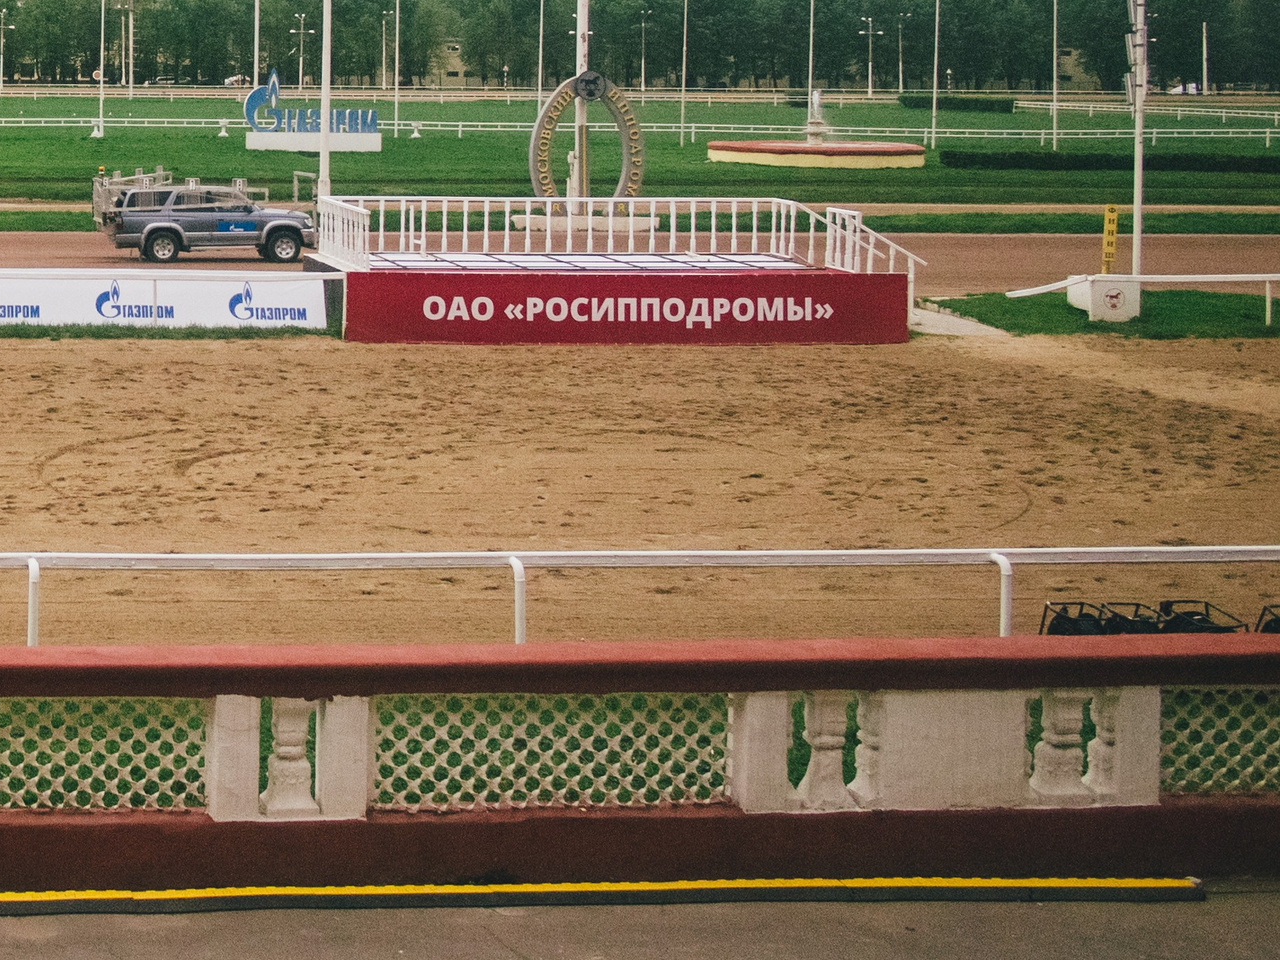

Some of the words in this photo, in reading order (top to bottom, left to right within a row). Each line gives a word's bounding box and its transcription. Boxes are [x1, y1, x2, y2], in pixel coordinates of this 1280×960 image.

[285, 108, 378, 134] ГАЗРОМ
[537, 88, 575, 197] МОСКОВСКИЙ
[607, 89, 642, 197] ИППОДРОМ
[255, 306, 307, 321] ГАЗПРОМ
[422, 295, 495, 322] ОАО
[503, 296, 835, 330] «РОСИППОДРОМЫ»
